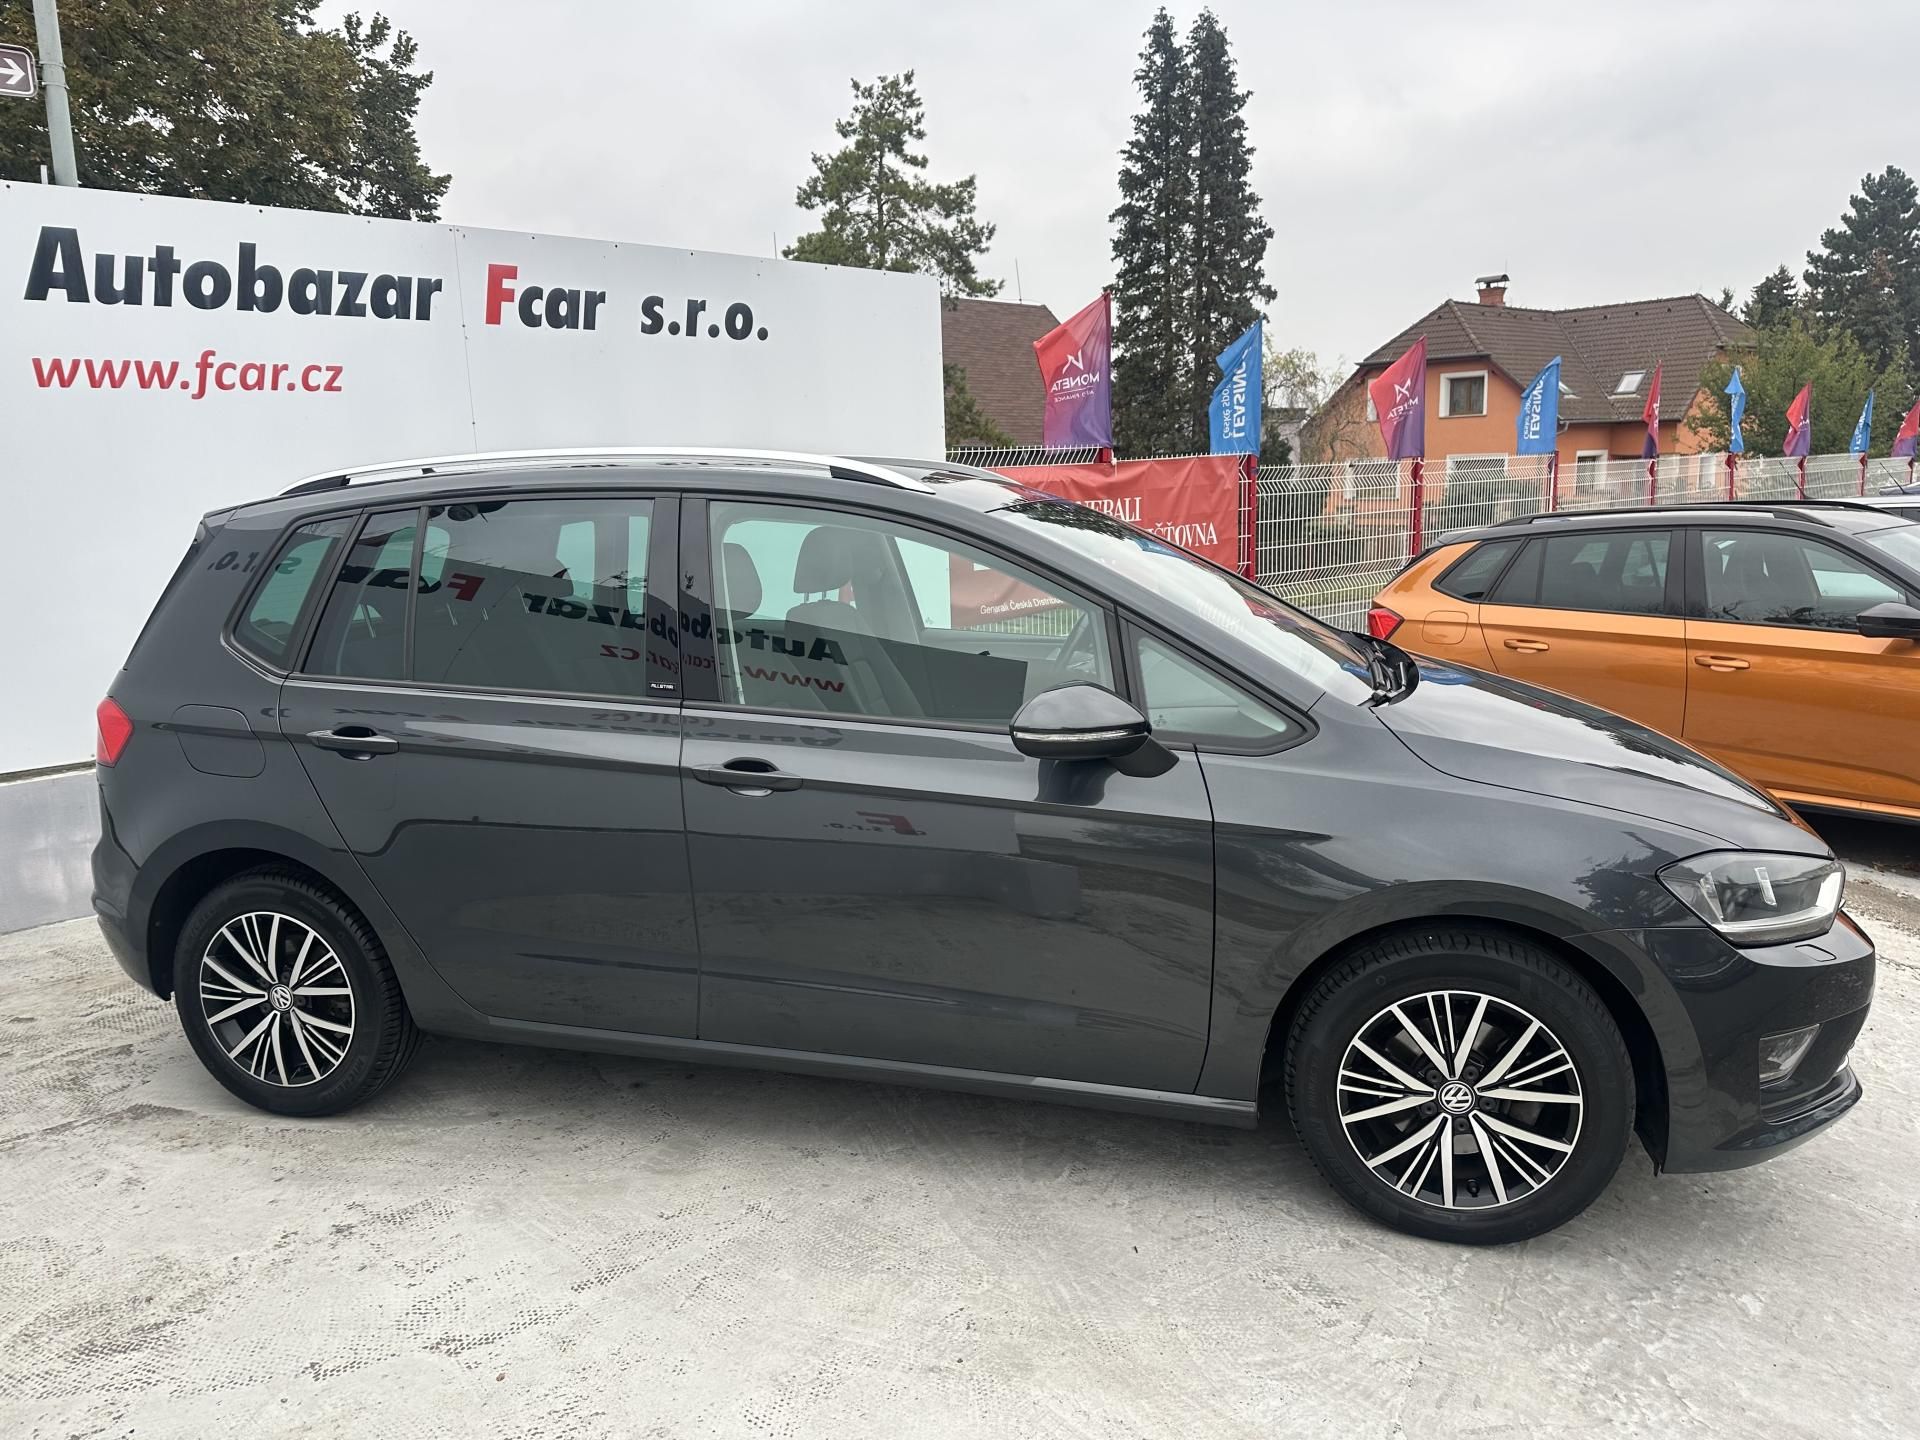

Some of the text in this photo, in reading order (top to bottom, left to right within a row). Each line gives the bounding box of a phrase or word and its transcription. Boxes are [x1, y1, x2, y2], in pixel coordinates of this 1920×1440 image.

[24, 225, 769, 341] Autobazar Fcar s.r.o.
[31, 349, 343, 400] www.fcar.cz
